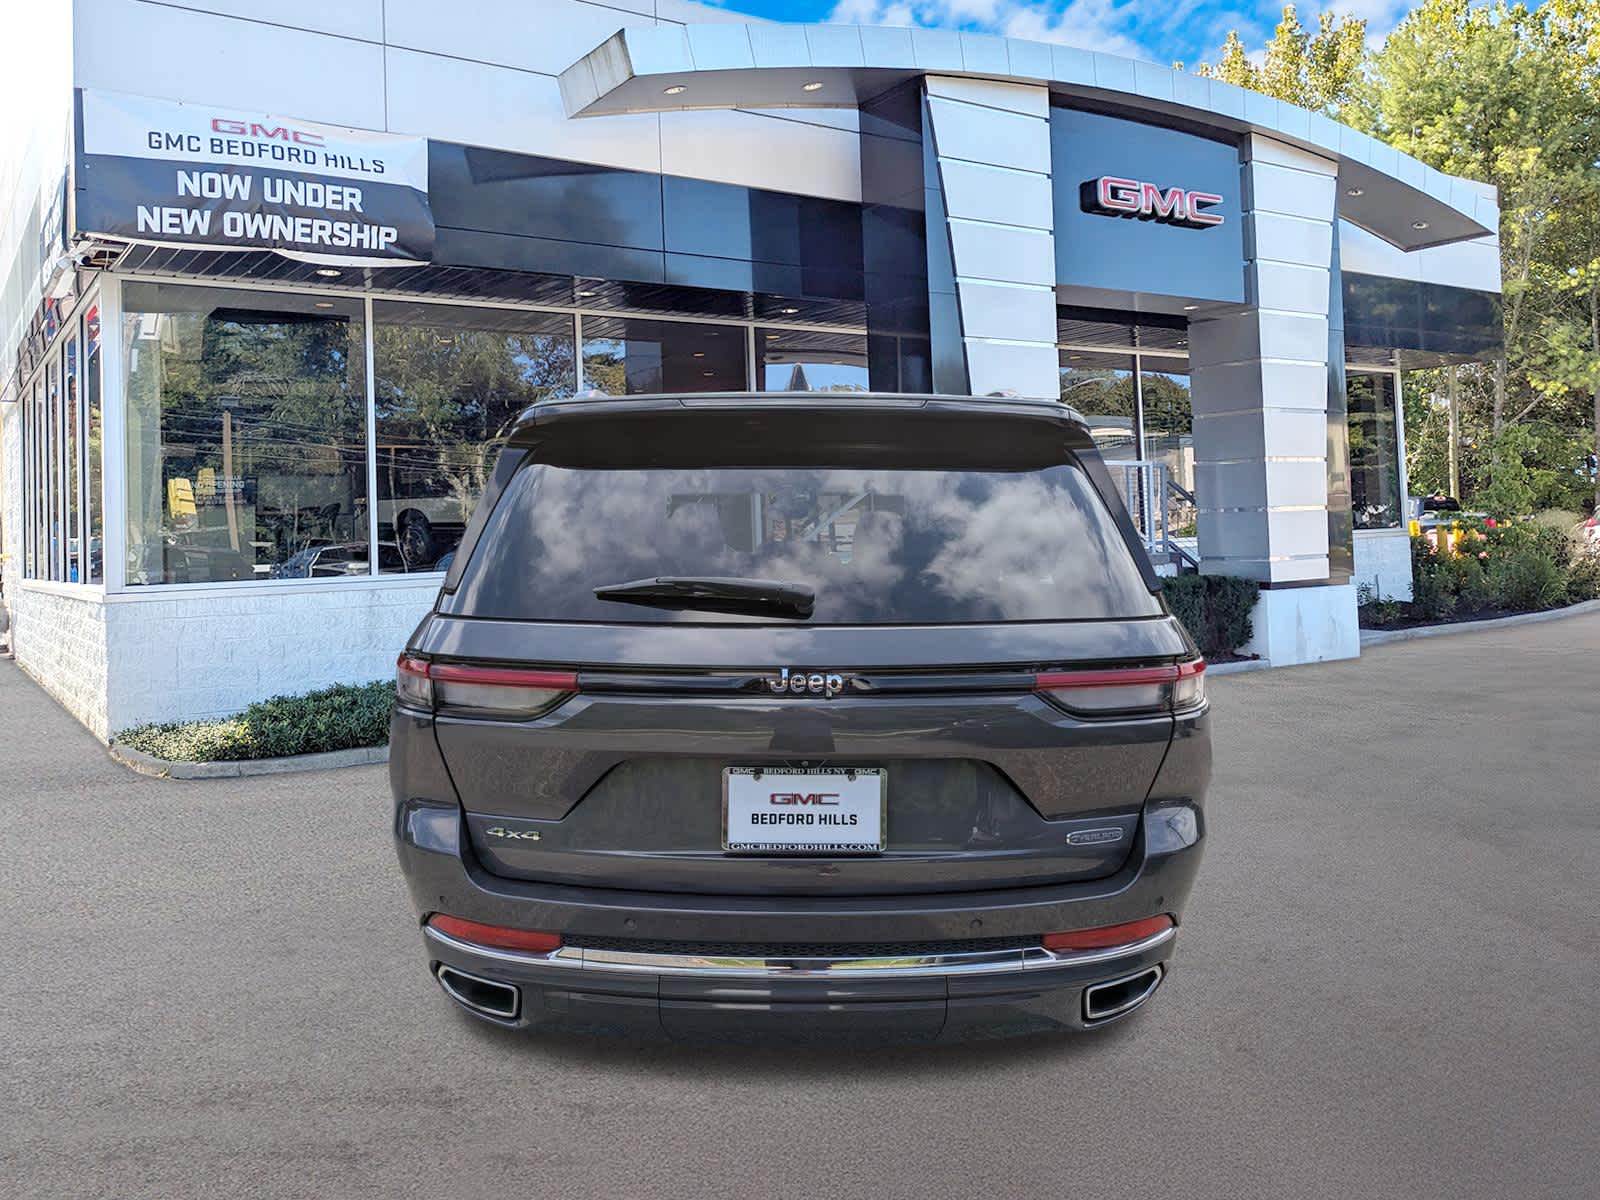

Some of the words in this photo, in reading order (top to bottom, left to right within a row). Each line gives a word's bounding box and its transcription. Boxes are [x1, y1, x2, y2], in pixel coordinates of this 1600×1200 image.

[211, 118, 325, 147] GMC
[148, 131, 201, 152] GMC
[210, 138, 317, 165] BEDFORD
[324, 153, 385, 174] HILLS
[177, 170, 252, 200] NOW
[263, 176, 363, 213] UNDER
[1098, 175, 1225, 225] GMC
[137, 206, 212, 236] NEW
[223, 211, 398, 250] OWNERSHIP
[769, 667, 843, 697] Jeep
[732, 767, 756, 775] GMC
[763, 767, 805, 775] BEDFORD
[807, 767, 832, 775] HILLS
[834, 767, 847, 775] NY
[854, 767, 878, 775] GMC
[769, 792, 840, 806] GMC
[751, 813, 814, 825] BEDFORD
[818, 813, 858, 826] HILLS
[730, 842, 879, 851] GMCBEDFORDHILLS.COM
